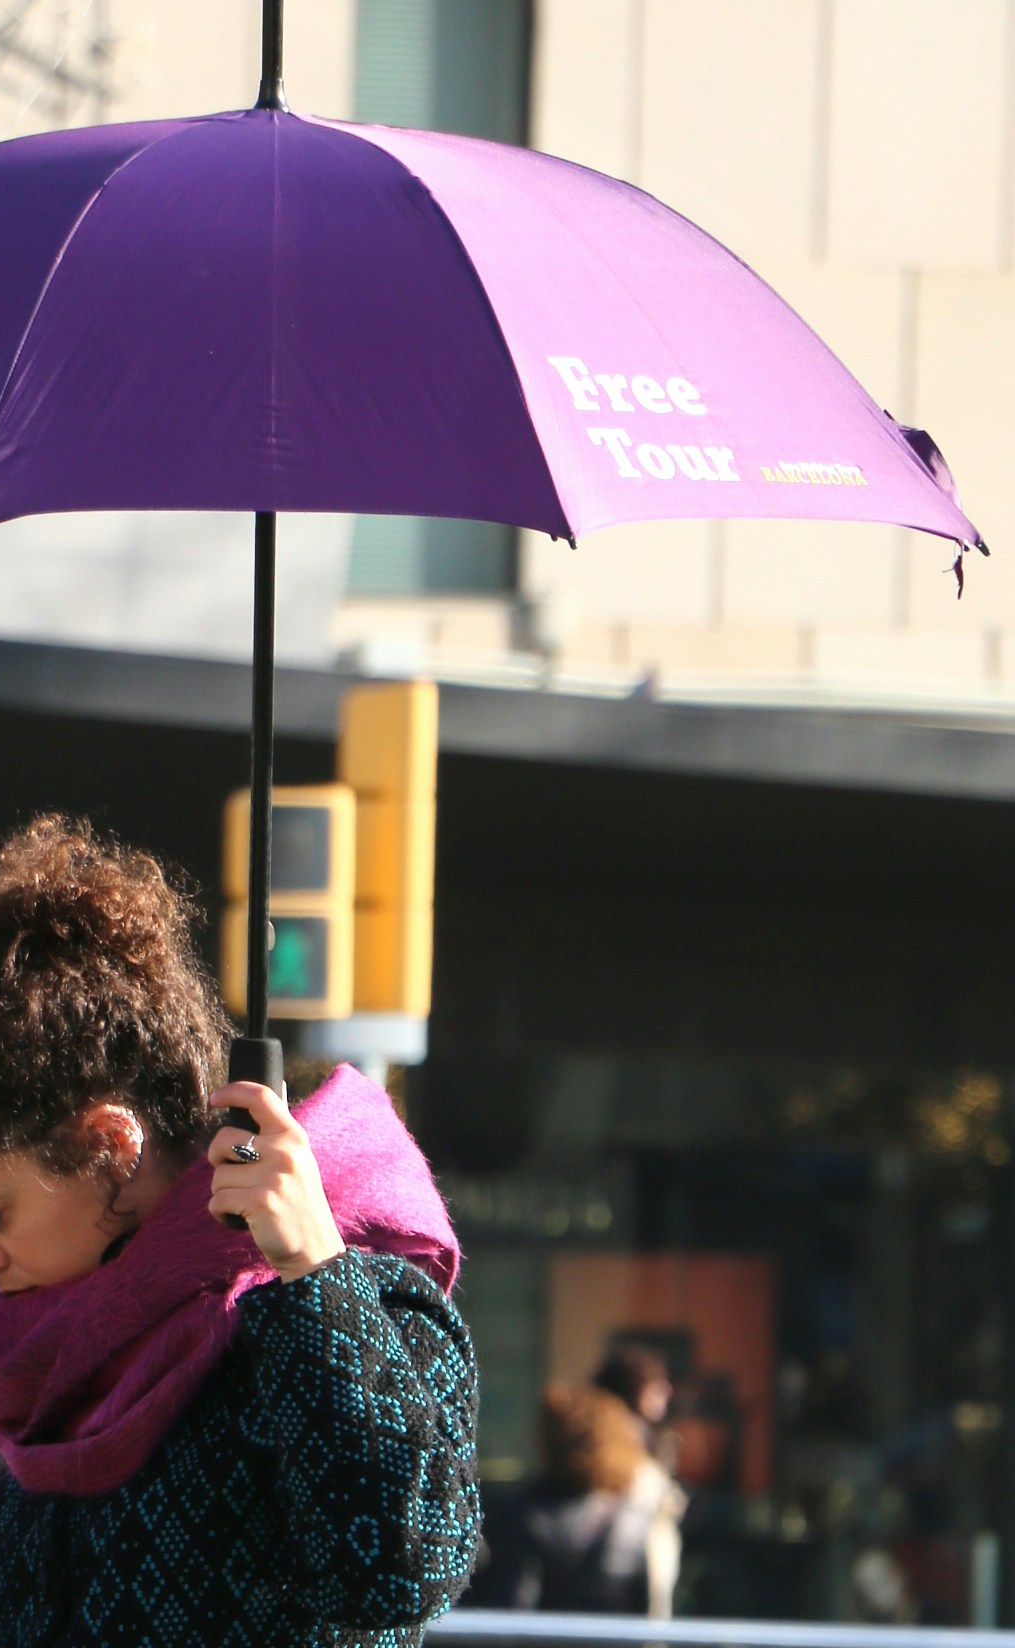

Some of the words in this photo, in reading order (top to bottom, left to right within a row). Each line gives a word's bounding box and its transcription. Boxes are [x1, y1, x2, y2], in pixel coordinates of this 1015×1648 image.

[547, 357, 709, 416] Free
[586, 428, 741, 482] Tour
[760, 464, 869, 486] BARCELONA
